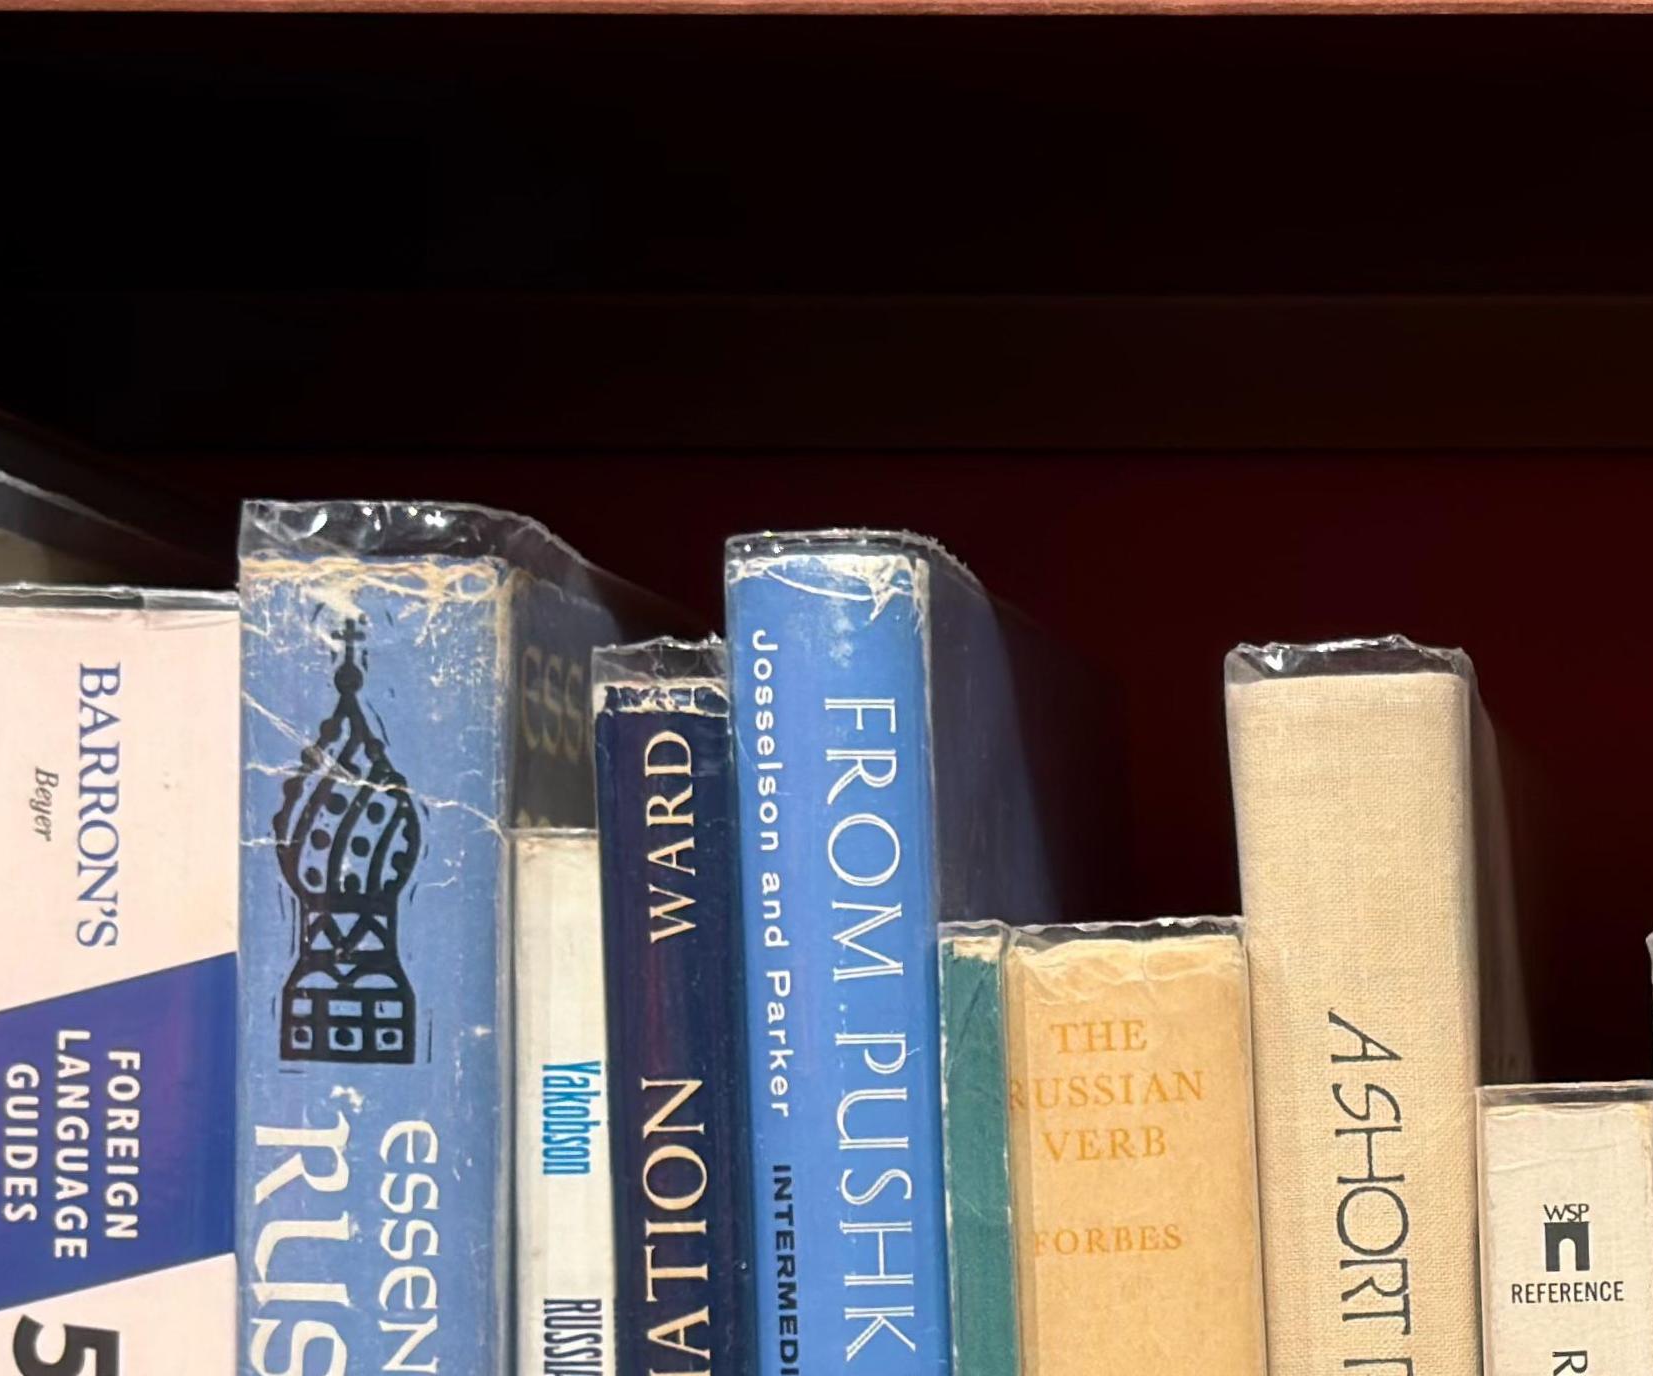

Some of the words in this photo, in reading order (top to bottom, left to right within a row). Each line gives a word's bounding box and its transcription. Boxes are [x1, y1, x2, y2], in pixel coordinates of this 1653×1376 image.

[751, 629, 779, 852] Josselson
[30, 766, 56, 842] Beyer
[75, 662, 121, 951] BARRON'S
[643, 729, 697, 943] WARD
[823, 697, 905, 981] FROM
[759, 872, 788, 949] and
[765, 970, 795, 1118] Parker
[1008, 1069, 1205, 1111] RUSSIAN
[1049, 1019, 1148, 1054] THE
[1328, 1006, 1404, 1065] A
[4, 1062, 38, 1223] GUIDES
[54, 1029, 90, 1260] LANGUAGE
[106, 1049, 142, 1241] FOREIGN
[542, 1060, 601, 1176] Yakobson
[1041, 1124, 1167, 1164] VERB
[1033, 1223, 1183, 1258] FORBES
[1330, 1081, 1413, 1336] SHORT
[1543, 1202, 1591, 1223] WSP
[1510, 1280, 1625, 1305] REFERENCE
